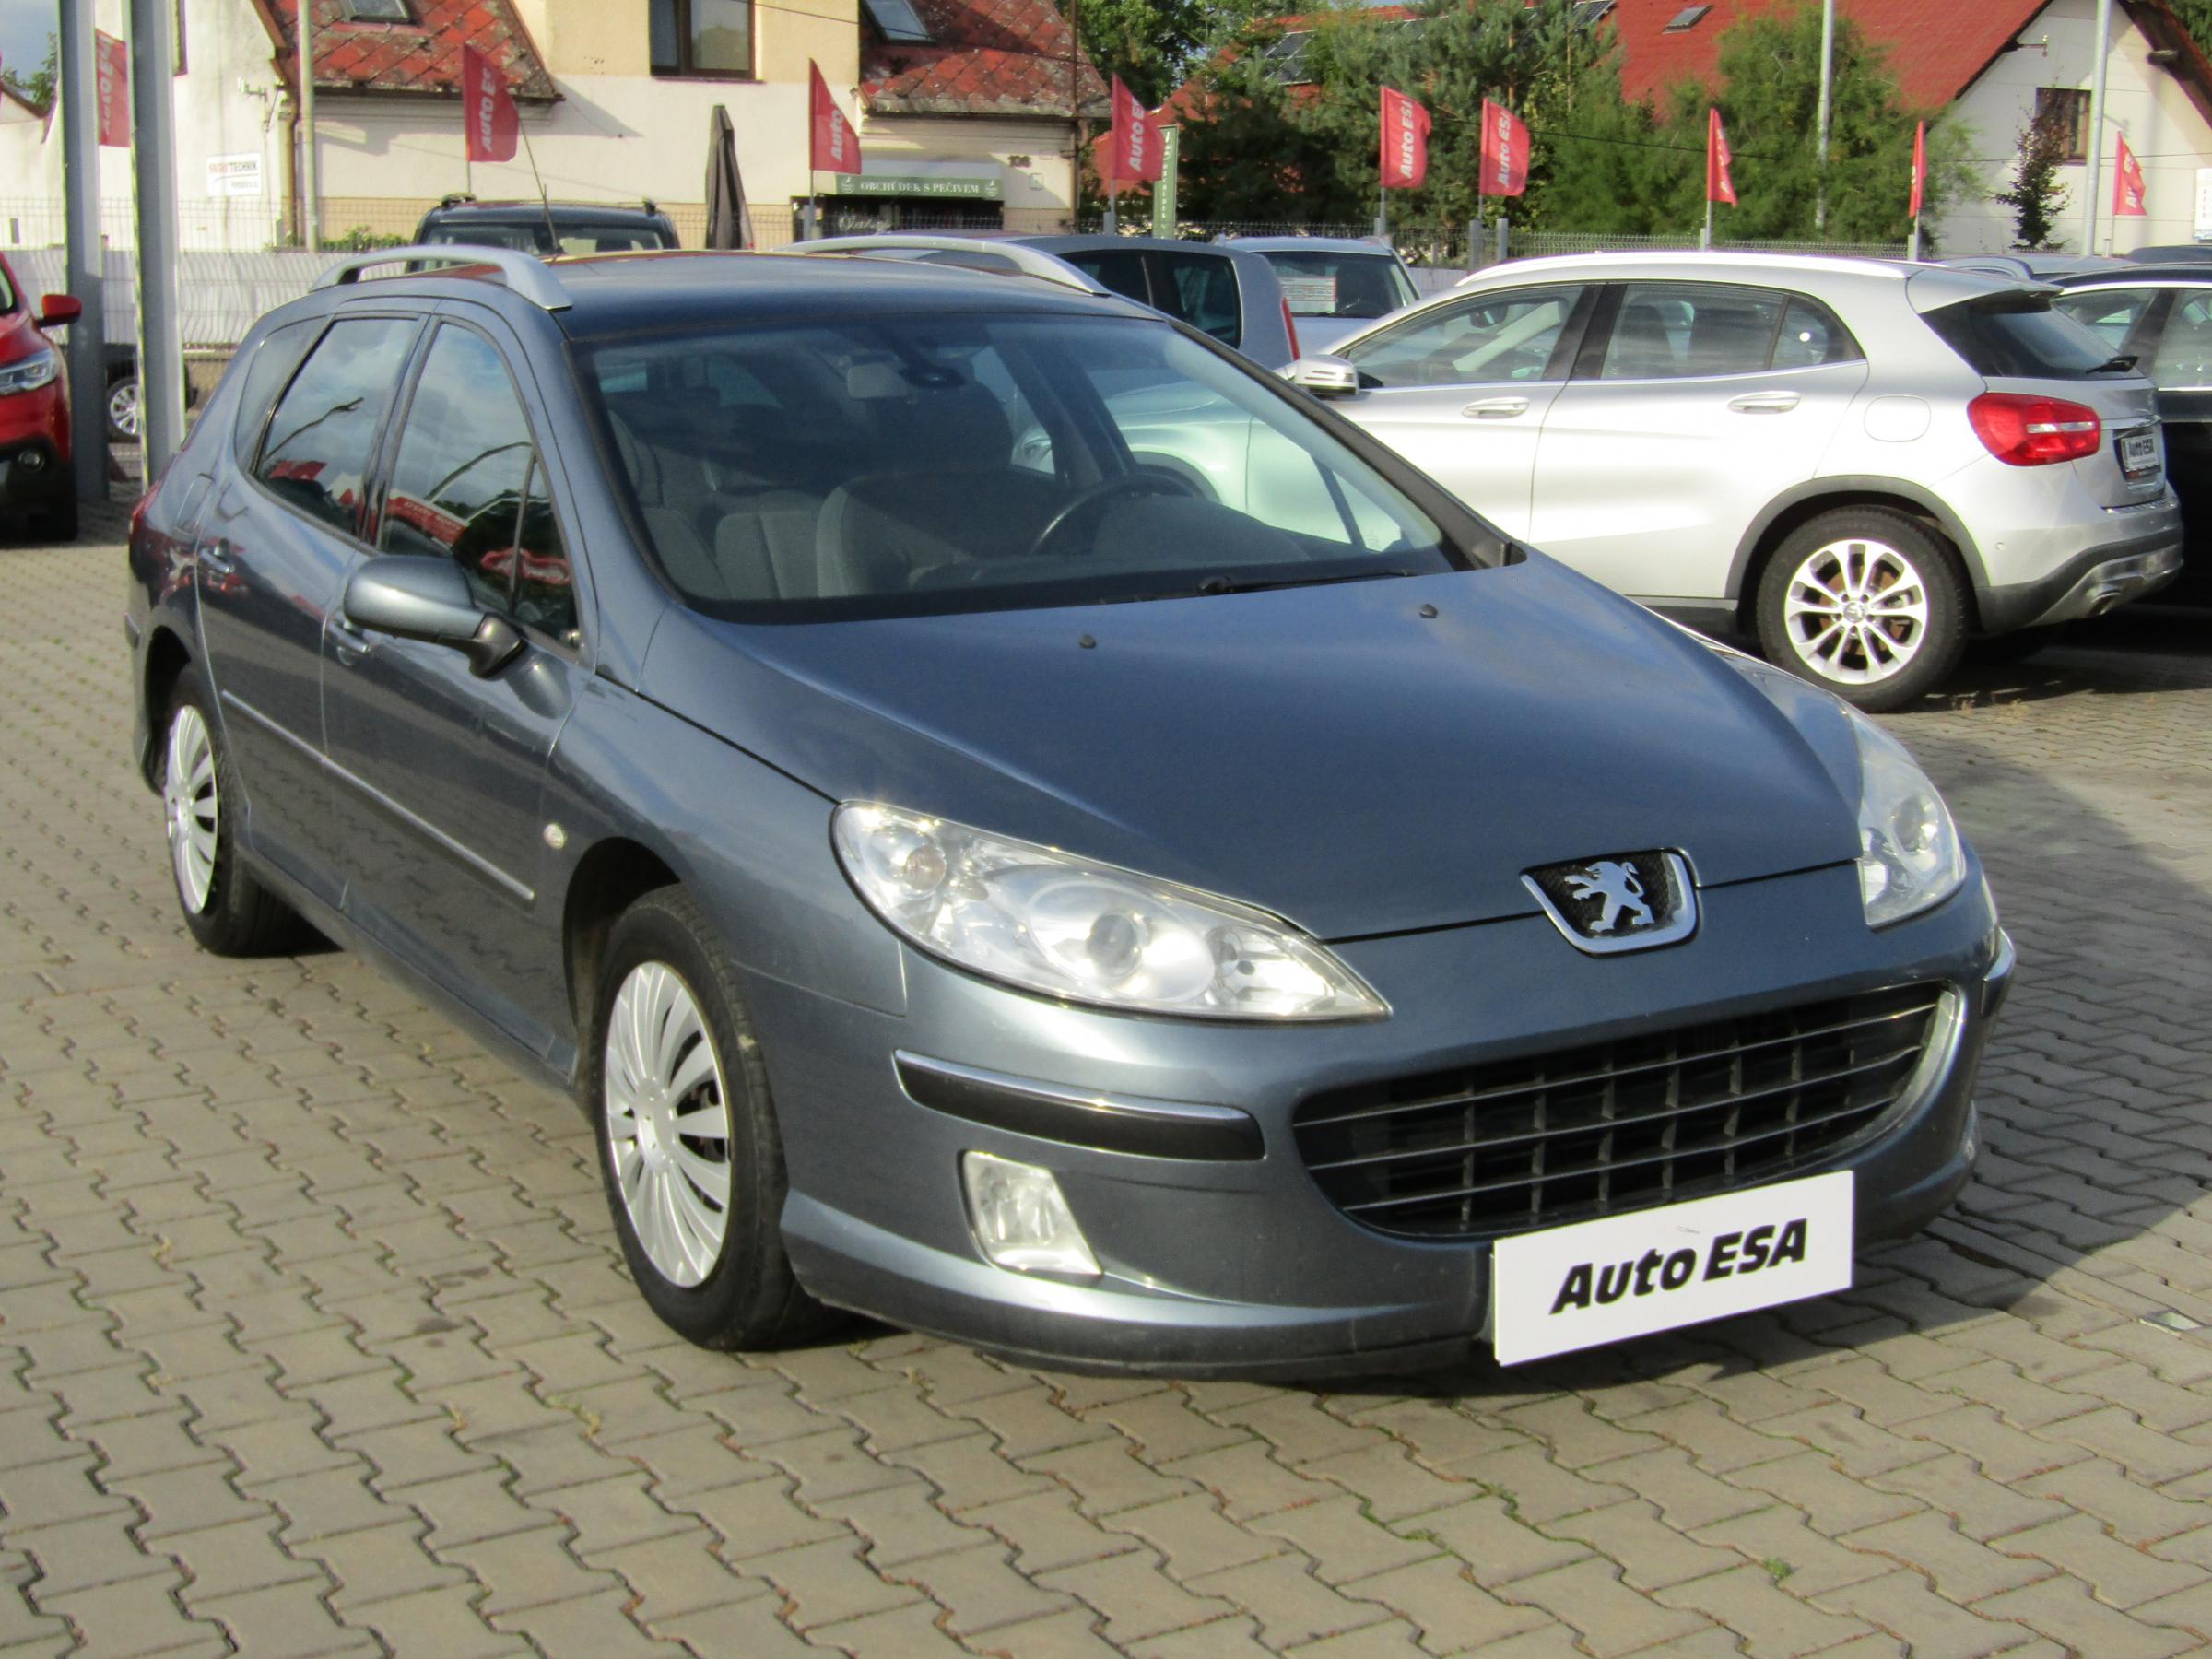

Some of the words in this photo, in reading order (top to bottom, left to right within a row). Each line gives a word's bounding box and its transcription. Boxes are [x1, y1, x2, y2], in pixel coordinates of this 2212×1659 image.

[479, 97, 494, 152] Auto
[830, 109, 844, 162] Auto
[1128, 121, 1145, 172] Auto
[1400, 131, 1415, 180] Auto
[1497, 142, 1511, 188] Auto
[1549, 1247, 1697, 1316] Auto
[1702, 1218, 1807, 1283] ESA
